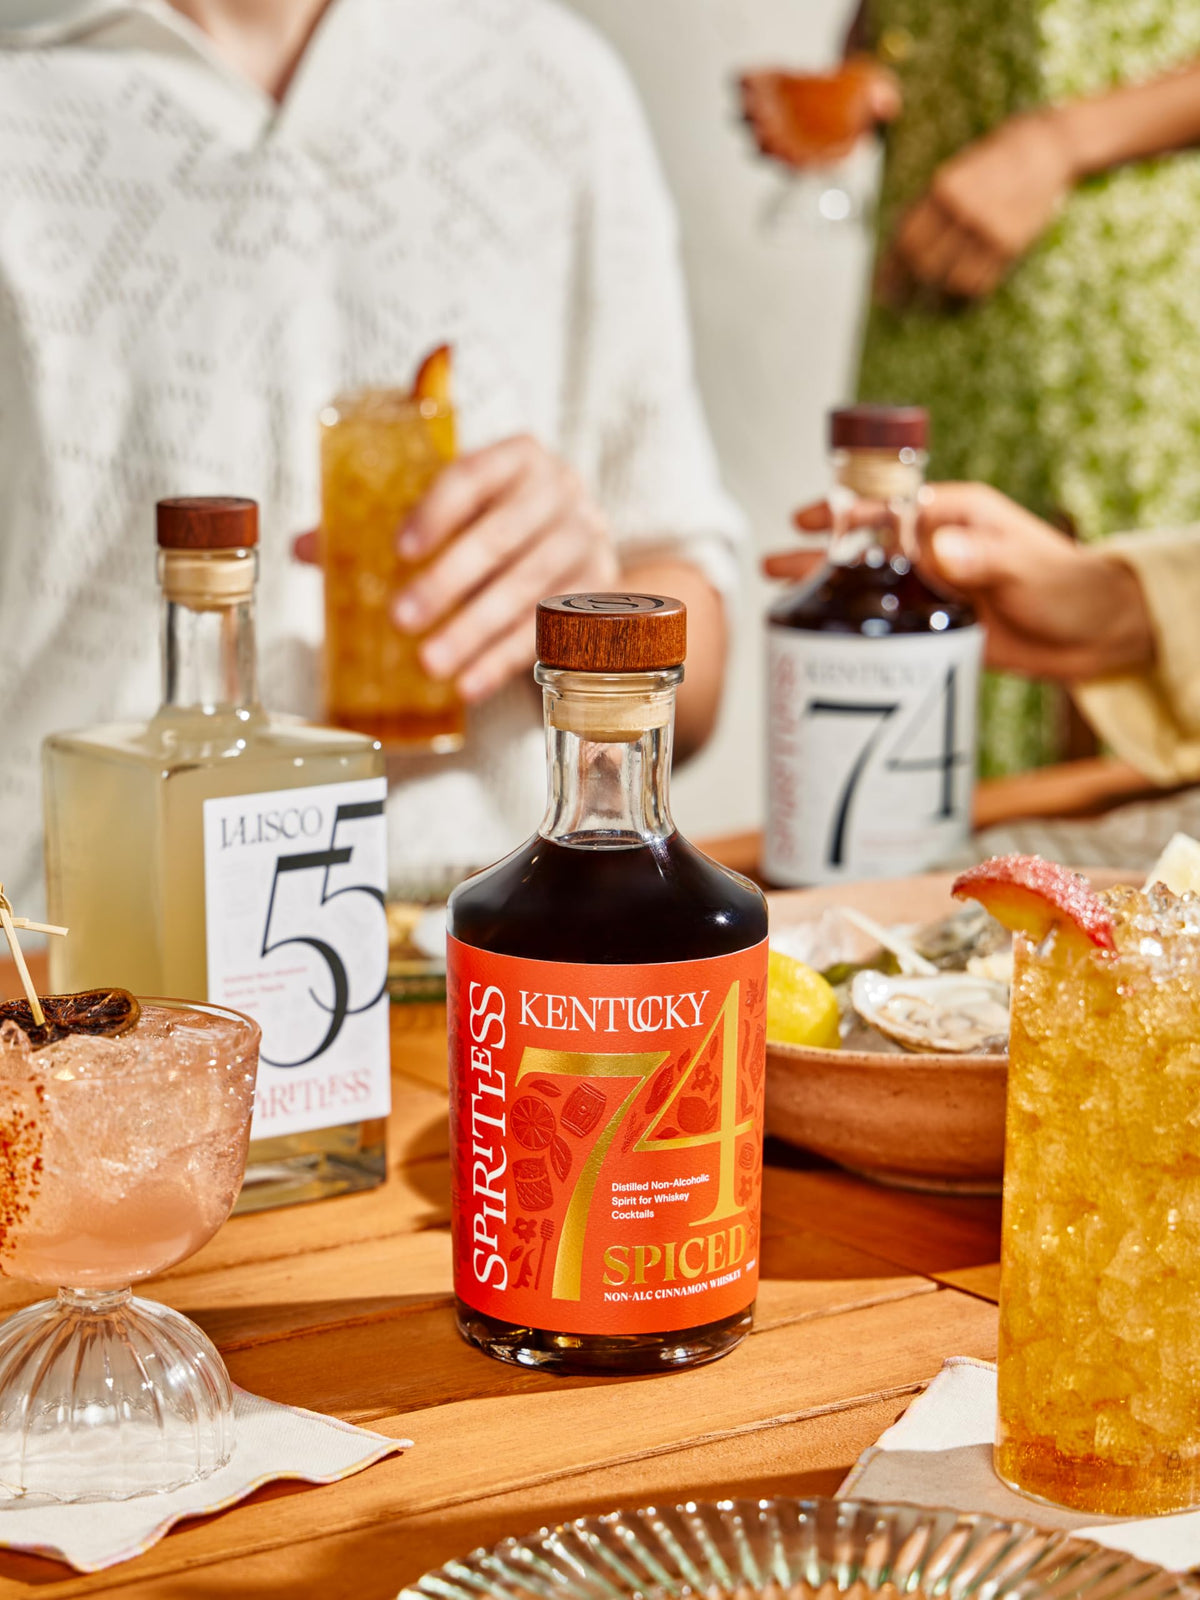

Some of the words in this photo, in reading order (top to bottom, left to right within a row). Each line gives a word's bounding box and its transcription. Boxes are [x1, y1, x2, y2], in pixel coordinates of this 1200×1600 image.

[807, 662, 970, 868] 74
[518, 990, 711, 1033] KENTUCKY
[255, 1066, 373, 1118] IRITLESS
[469, 981, 508, 1291] SPIRITLESS
[514, 980, 754, 1301] 74
[611, 1182, 649, 1192] Distilled
[651, 1173, 710, 1190] Non-Alcoholic
[611, 1195, 637, 1207] Spirit
[639, 1194, 652, 1205] for
[654, 1192, 690, 1204] Whiskey
[611, 1209, 655, 1220] Cocktails
[602, 1223, 747, 1286] SPICED
[603, 1290, 653, 1302] NON-ALC
[654, 1281, 709, 1299] CINNAMON
[709, 1267, 742, 1288] WHISKEY
